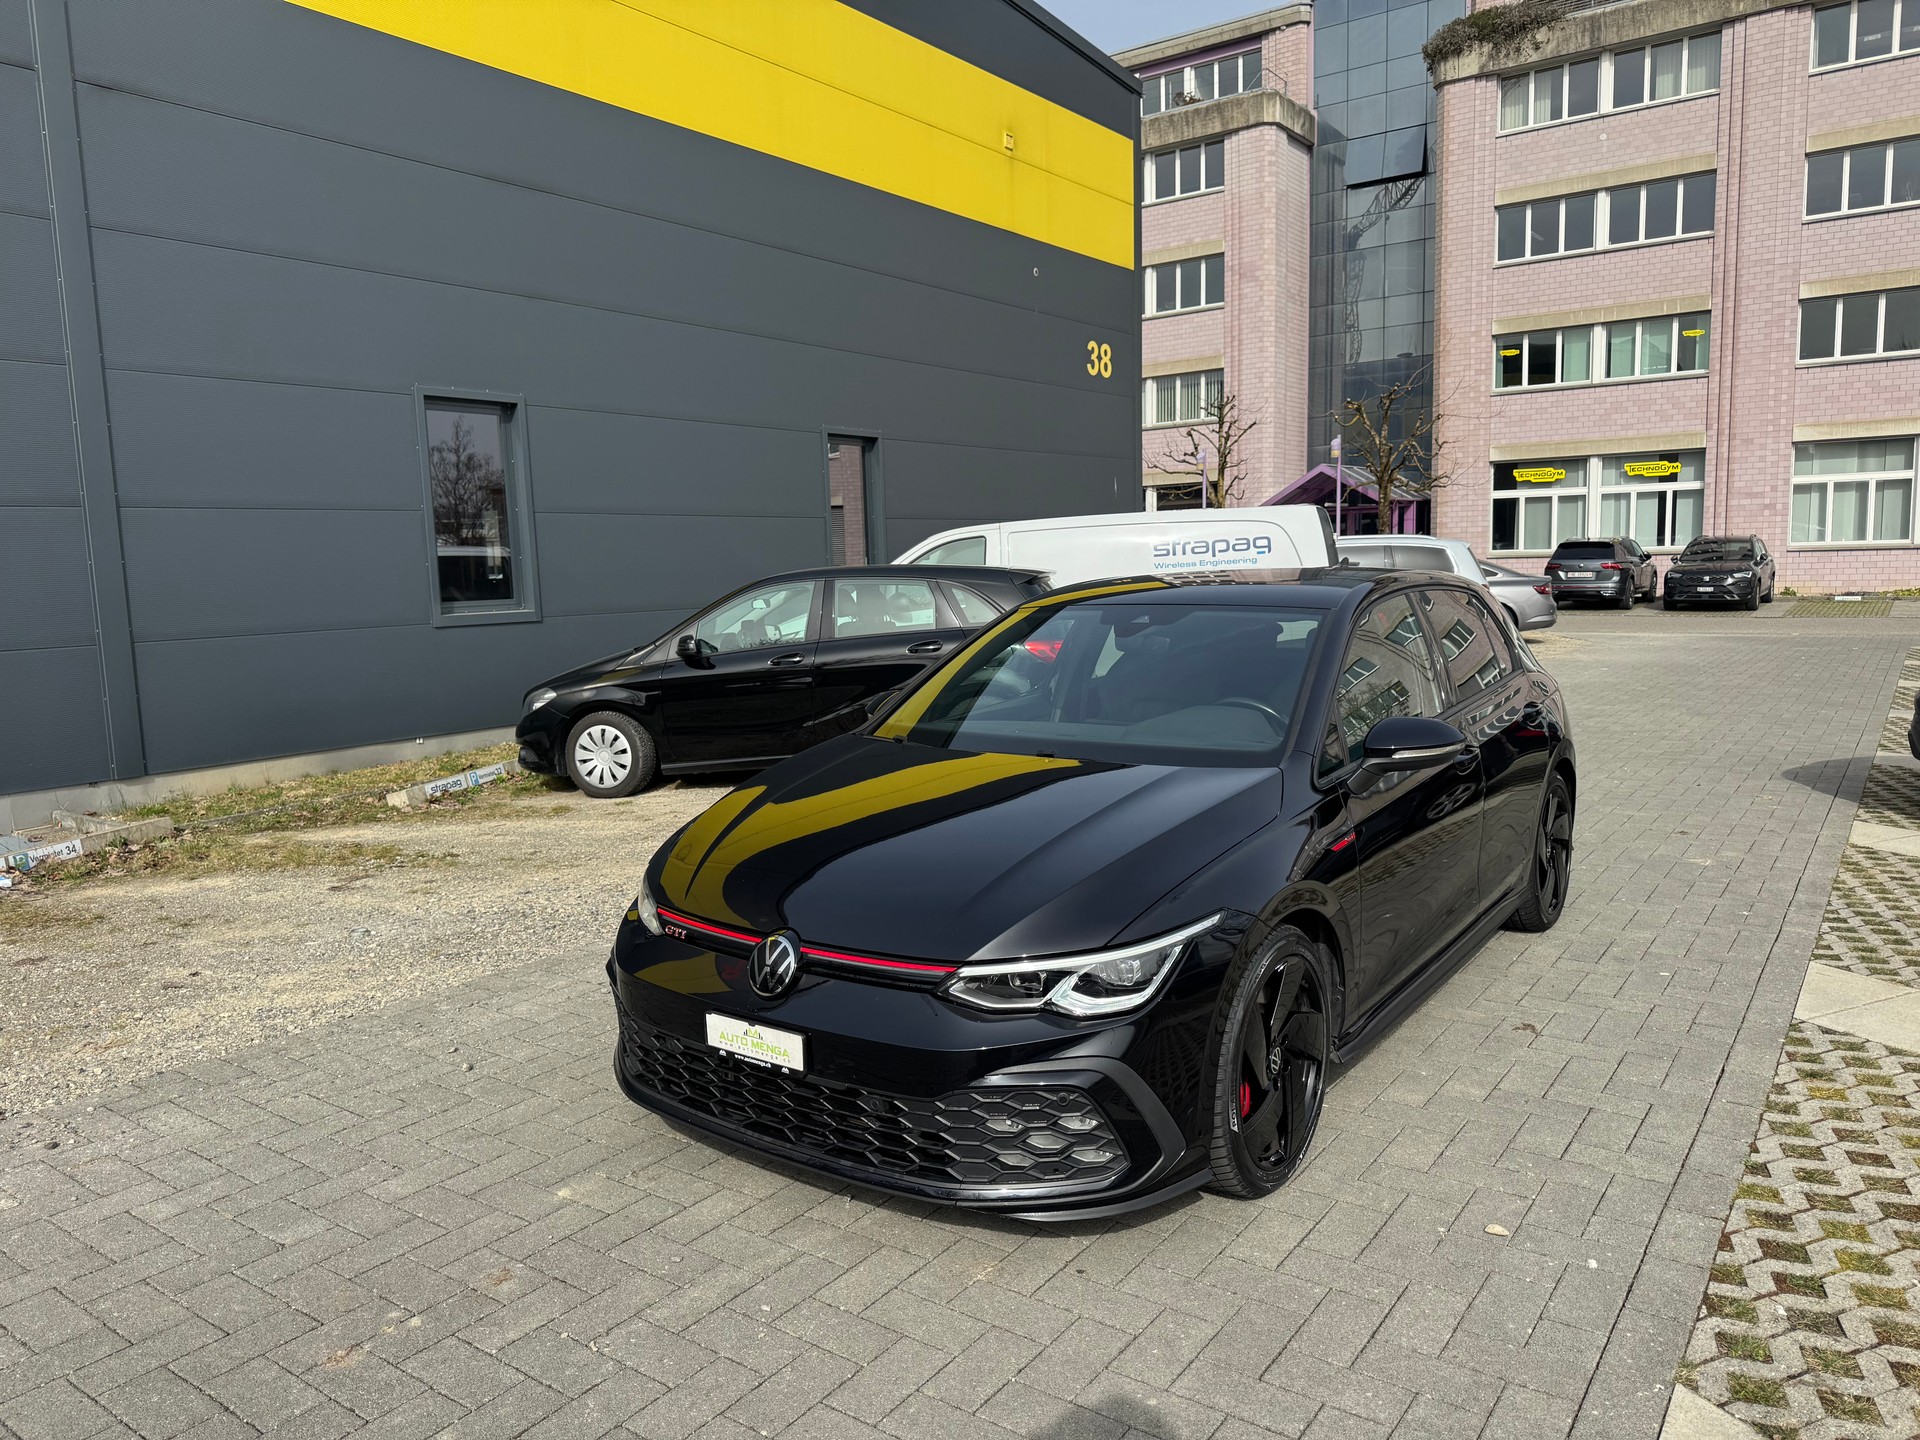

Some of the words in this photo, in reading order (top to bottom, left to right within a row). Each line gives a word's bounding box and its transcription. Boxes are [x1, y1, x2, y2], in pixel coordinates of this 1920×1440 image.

[1086, 340, 1112, 379] 38
[1153, 536, 1272, 557] strapag
[1154, 561, 1197, 570] Wireless
[1199, 557, 1258, 567] Engineering
[431, 779, 463, 794] strapag
[65, 844, 78, 856] 34
[665, 925, 687, 940] GTI
[719, 1031, 748, 1047] AUTO
[751, 1039, 790, 1058] MENGA
